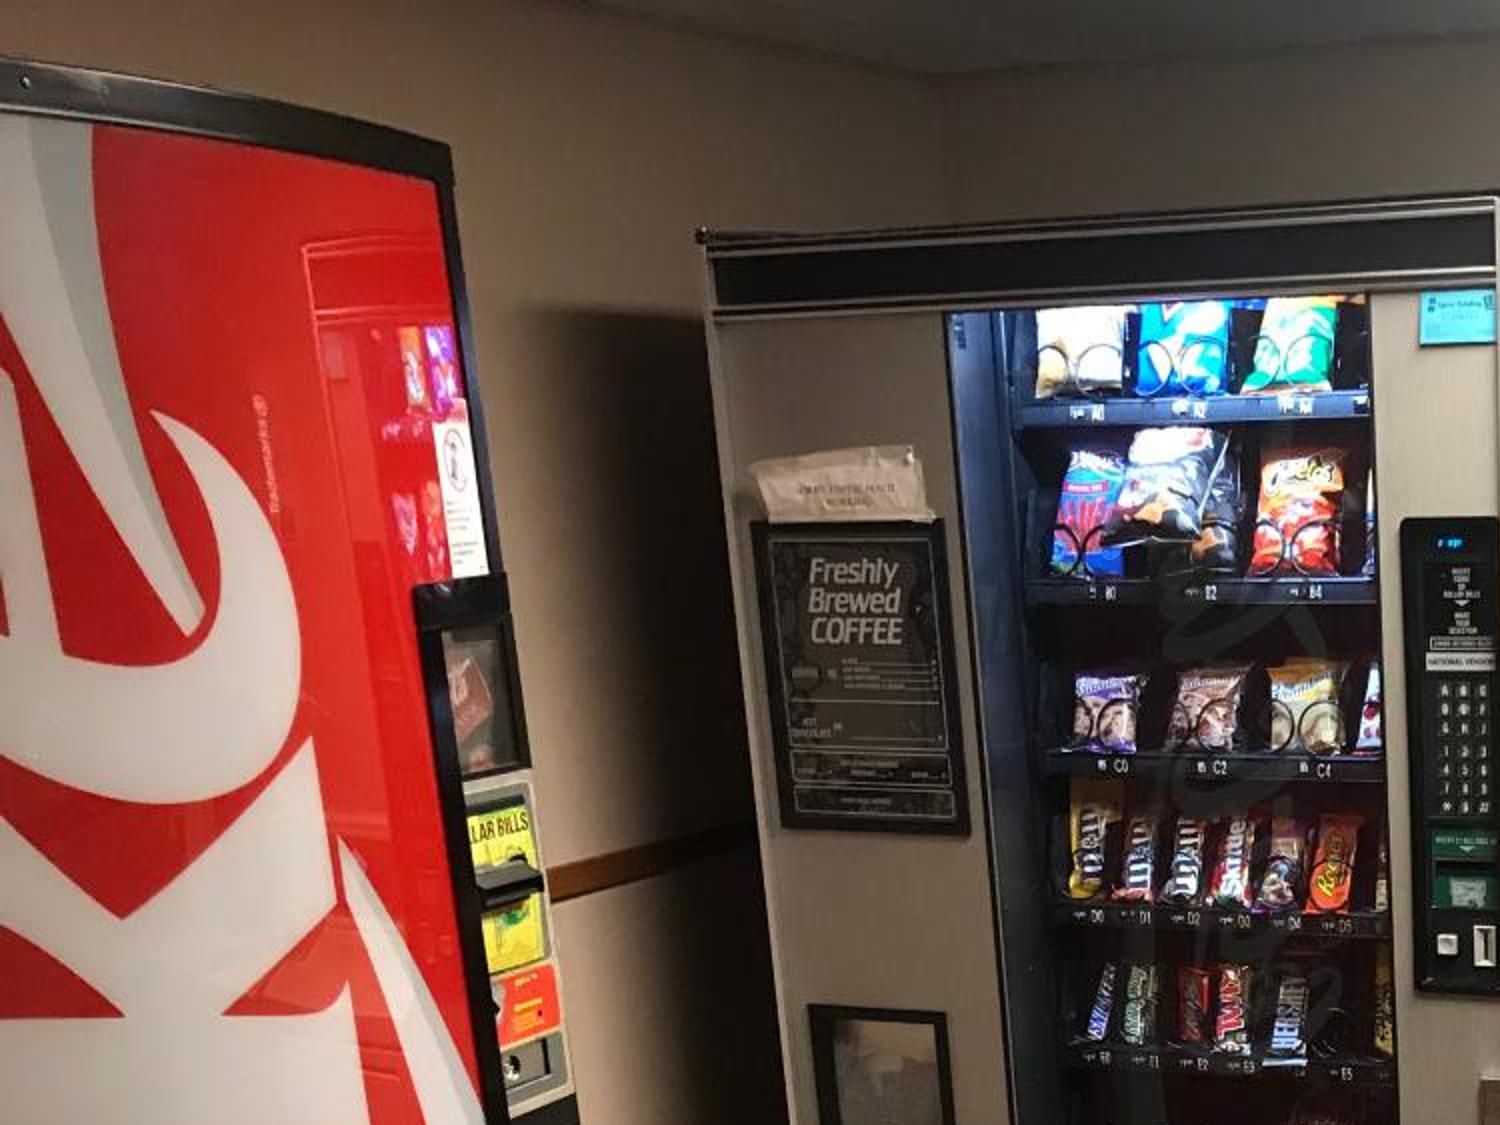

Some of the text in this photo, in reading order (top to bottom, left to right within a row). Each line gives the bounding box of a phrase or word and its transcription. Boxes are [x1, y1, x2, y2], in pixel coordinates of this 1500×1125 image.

[809, 558, 899, 588] Freshly
[808, 587, 901, 614] Brewed
[811, 617, 903, 645] COFFEE
[1113, 759, 1129, 773] C0
[1212, 760, 1228, 775] C2
[1316, 763, 1331, 779] C4
[496, 811, 529, 839] BILLS
[1341, 1067, 1353, 1081] E5
